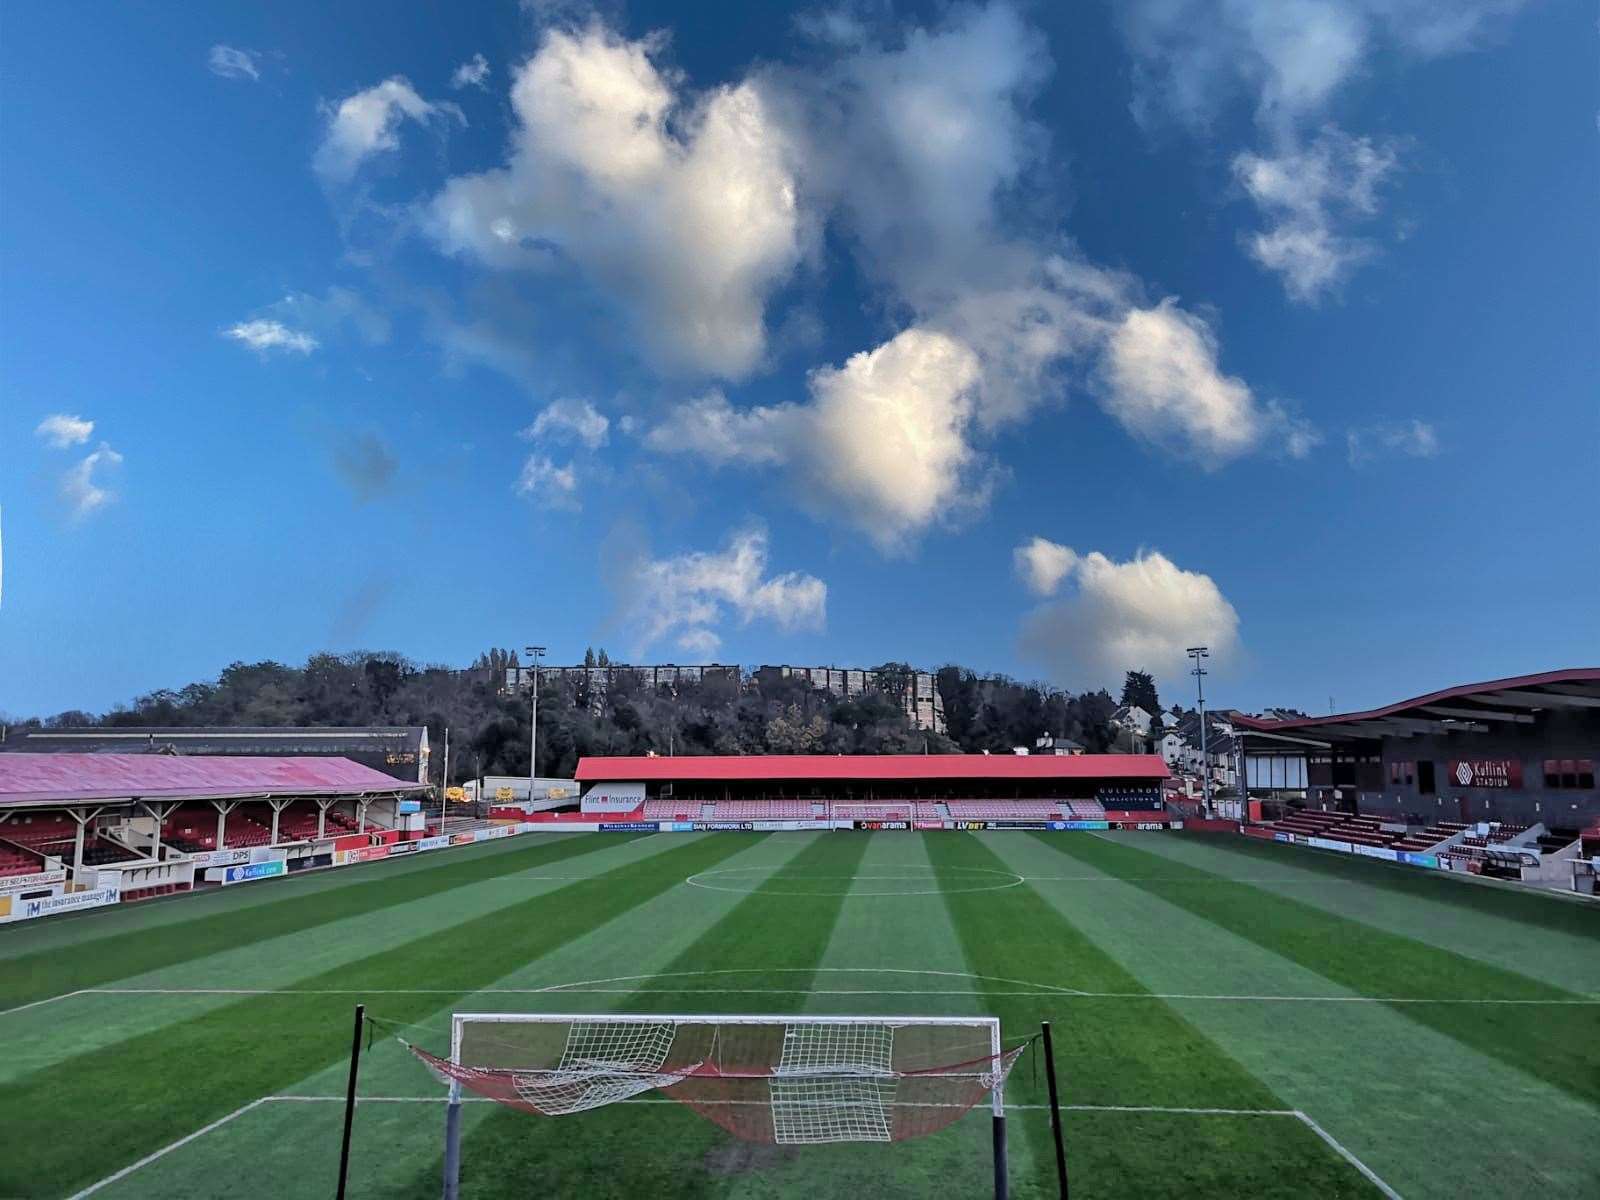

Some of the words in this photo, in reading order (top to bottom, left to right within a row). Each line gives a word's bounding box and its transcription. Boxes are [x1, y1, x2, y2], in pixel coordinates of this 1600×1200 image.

[1474, 761, 1507, 776] Kuflink
[1475, 778, 1508, 787] STADIUM
[609, 793, 641, 804] Insurance
[741, 822, 753, 830] LTD
[868, 821, 907, 830] vanarama
[233, 850, 248, 861] DPS
